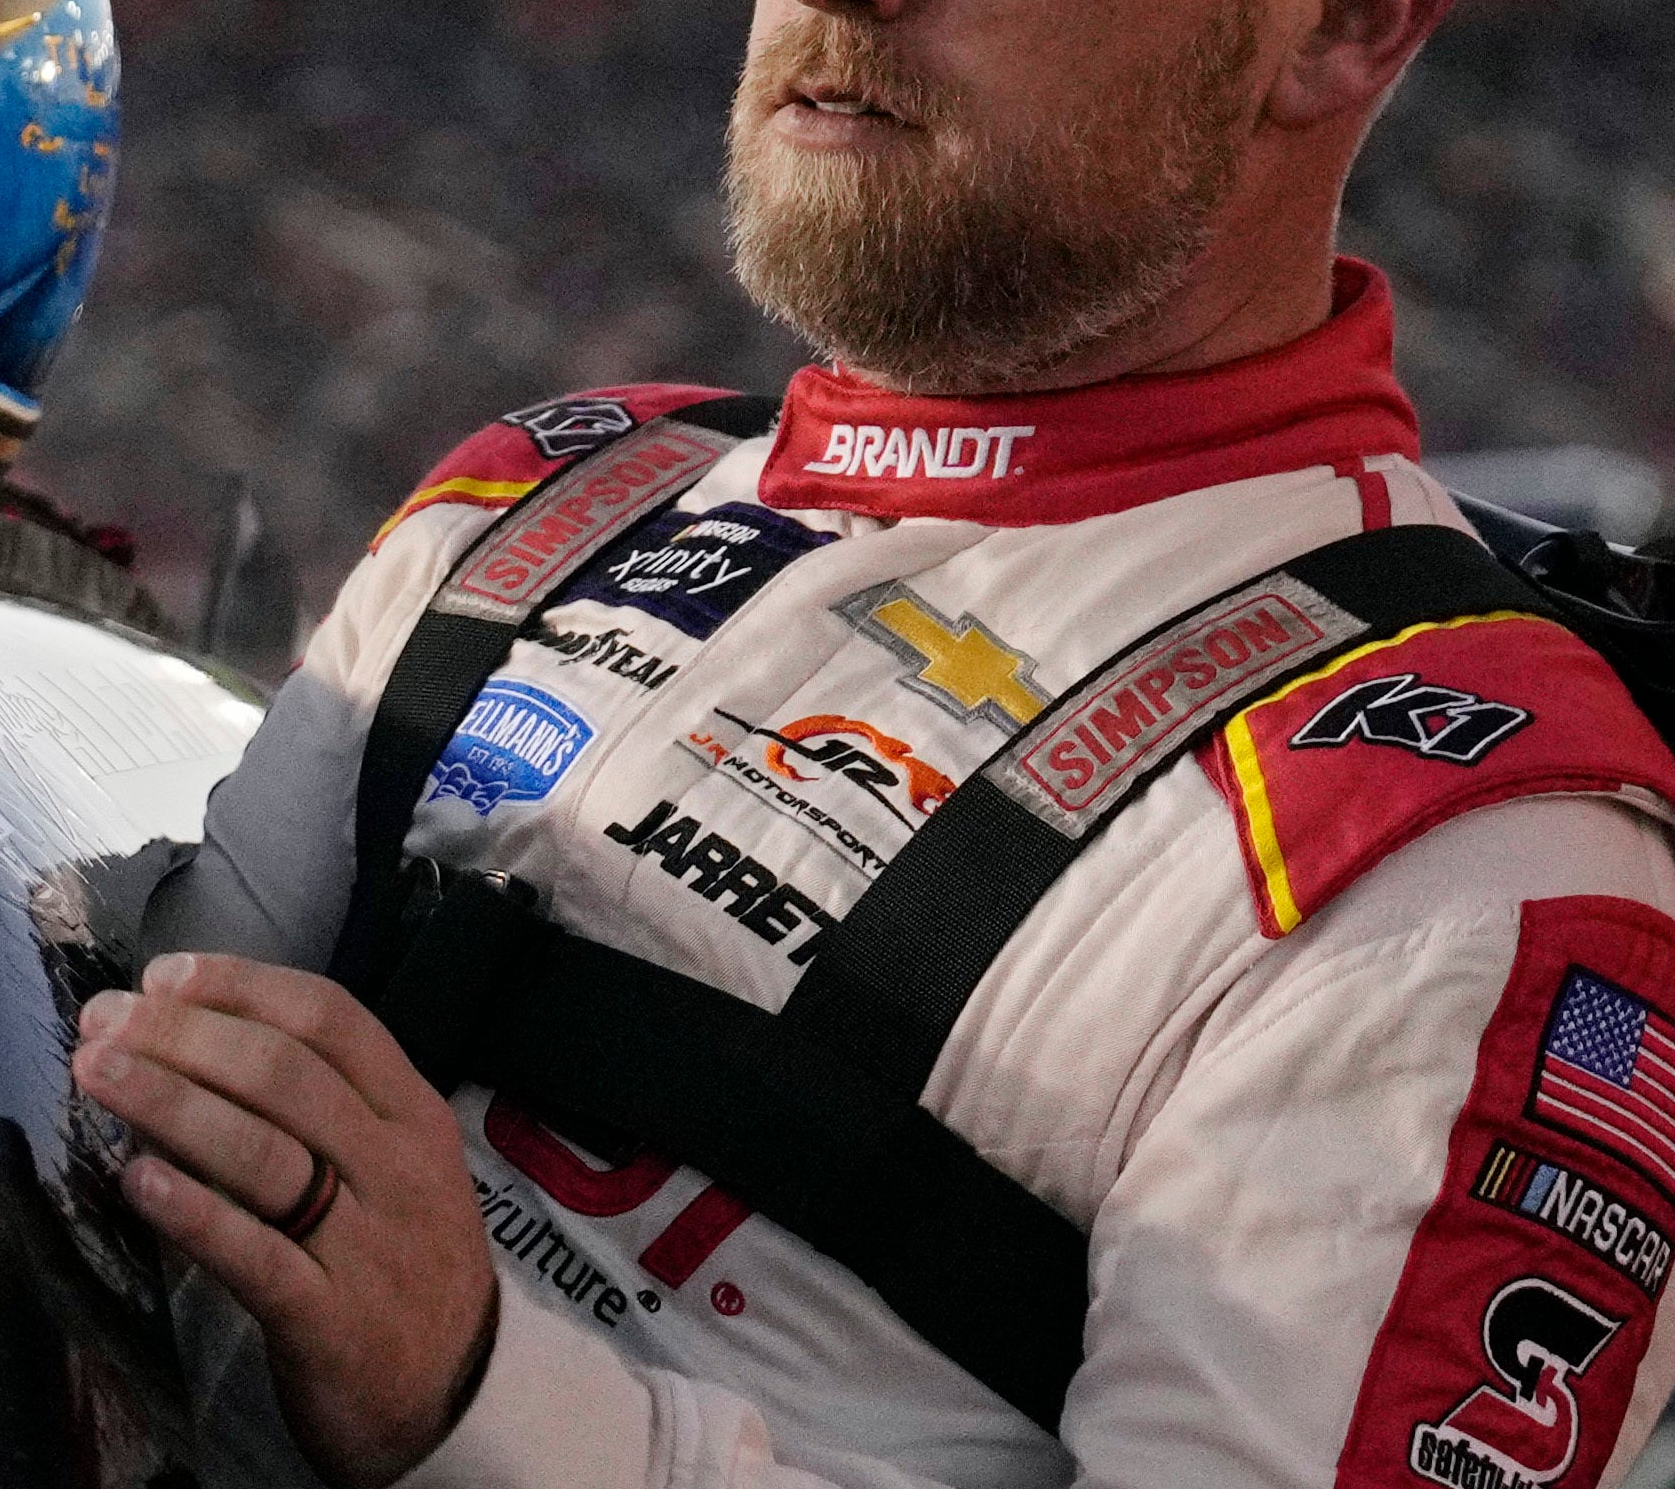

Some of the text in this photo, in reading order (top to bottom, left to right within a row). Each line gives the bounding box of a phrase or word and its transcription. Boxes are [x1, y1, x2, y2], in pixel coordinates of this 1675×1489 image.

[484, 440, 688, 591] SIMPSON
[609, 544, 752, 594] xfinity
[454, 699, 576, 777] ELLMANN'S
[1048, 607, 1296, 790] SIMPSON
[1544, 1169, 1671, 1294] NASCAR
